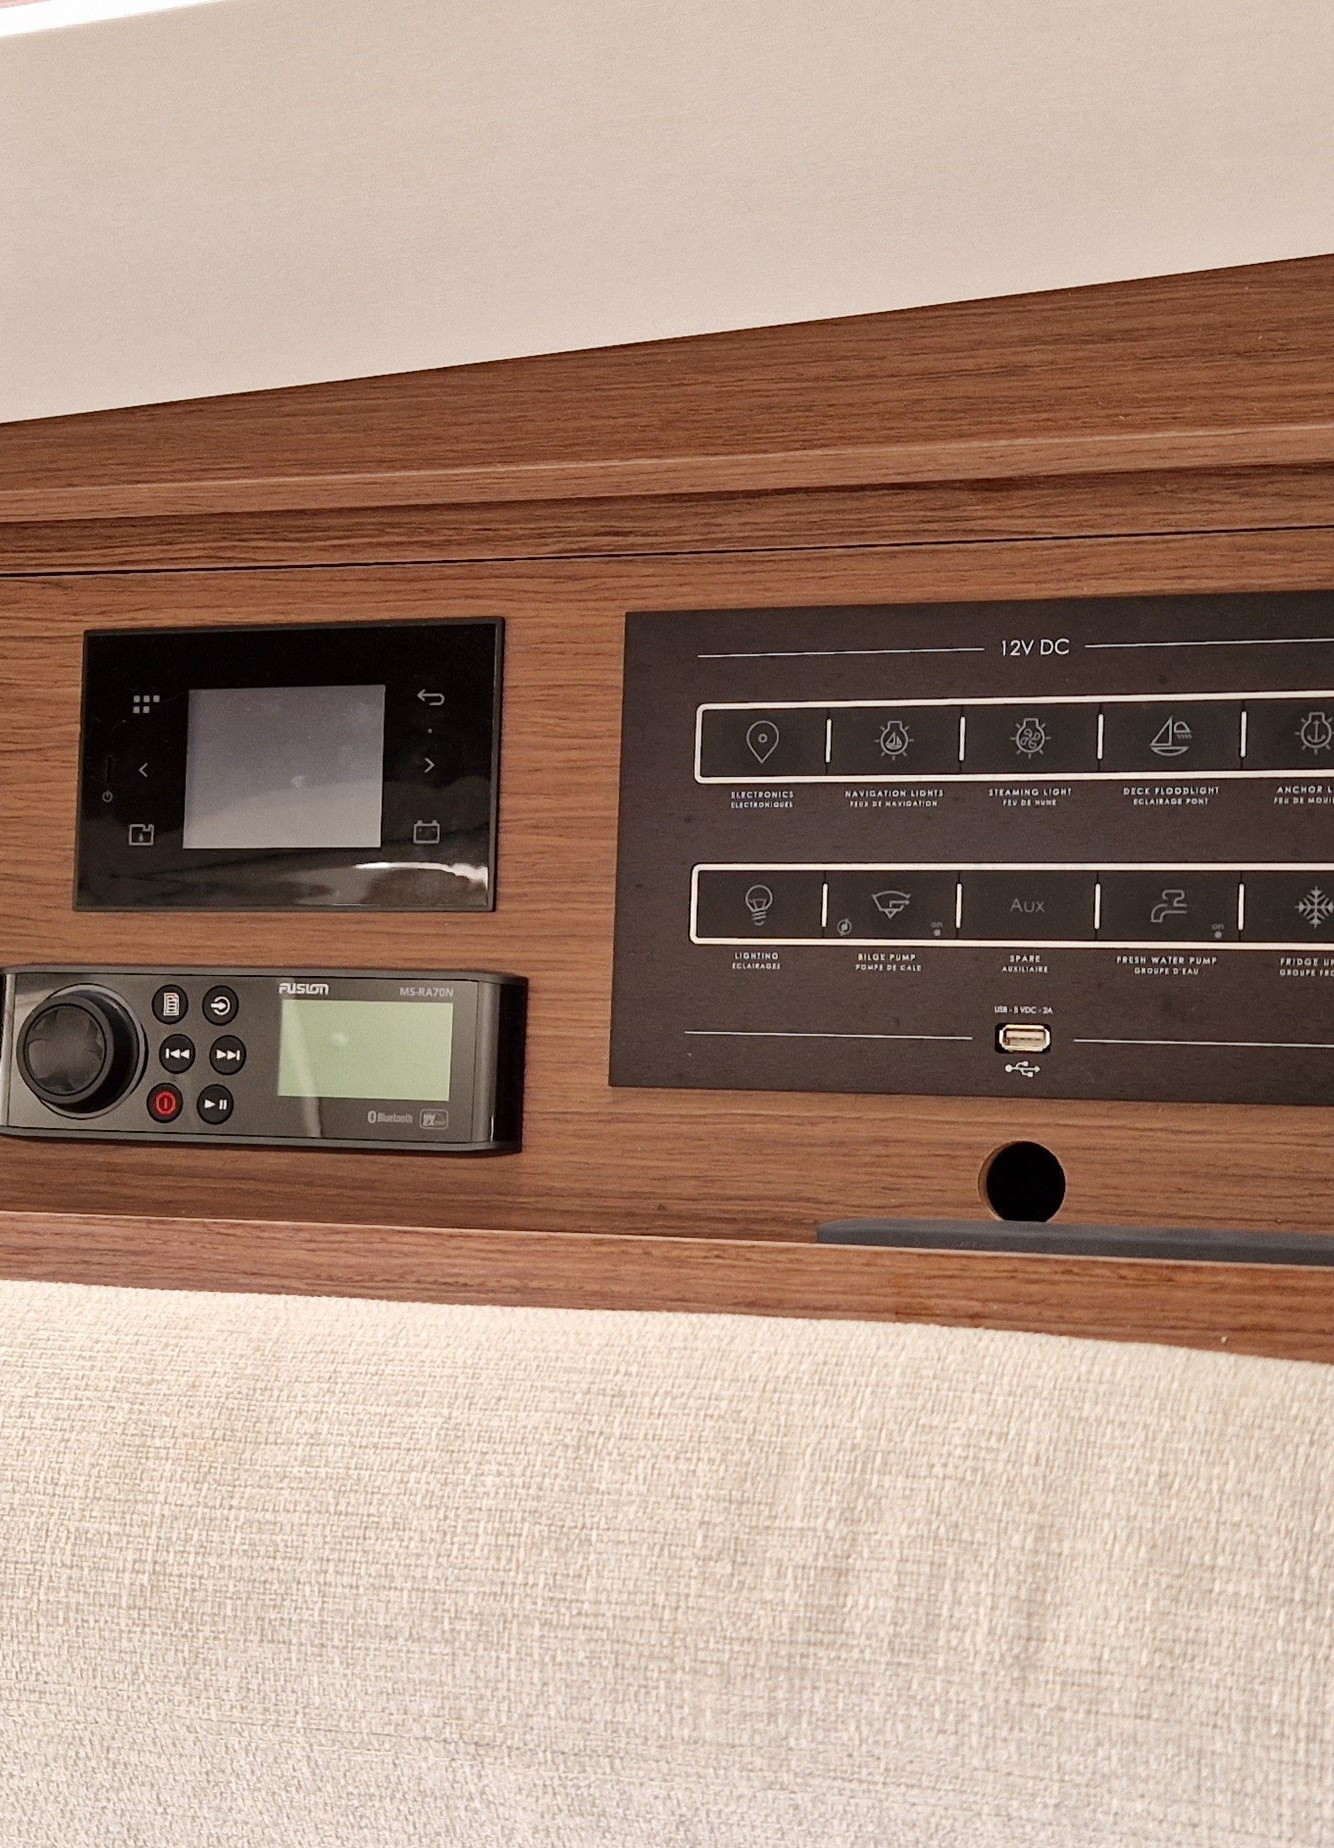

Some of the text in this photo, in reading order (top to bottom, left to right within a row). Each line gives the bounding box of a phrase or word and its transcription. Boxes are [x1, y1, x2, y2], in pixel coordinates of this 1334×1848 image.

[1001, 638, 1070, 656] 12V DC
[844, 789, 944, 798] NAVIGATION LIGHTS
[988, 787, 1072, 797] STEAMING LIGHT
[1123, 786, 1219, 796] DECK FLOODLIGHT
[1276, 785, 1323, 794] ANCHOR
[730, 790, 794, 799] ELECTRONICS
[730, 800, 793, 809] ELECTRONIQUES
[849, 799, 938, 808] FEUX DE NAVIGATION
[1002, 798, 1018, 807] FEU
[1020, 798, 1032, 807] DE
[1133, 797, 1208, 806] ECLAIRAGE PONT
[1273, 796, 1289, 805] FEU
[1292, 796, 1304, 805] DE
[1211, 923, 1225, 931] on
[734, 951, 779, 960] LIGHTING
[857, 952, 916, 962] BILGE PUMP
[1009, 954, 1041, 963] SPARE
[1116, 955, 1217, 965] FRESH WATER PUMP
[731, 962, 781, 970] ECLAIRAGES
[1280, 957, 1319, 967] FRIDGE
[855, 963, 922, 972] POMPE DE CALE
[1001, 965, 1048, 973] AUXILIAIRE
[1134, 967, 1199, 976] GROUPE D'EAU
[1279, 968, 1316, 977] GROUPE
[399, 986, 455, 998] MS-RA70N
[1019, 1005, 1037, 1015] VDC
[1042, 1006, 1053, 1015] 2A
[377, 1112, 413, 1124] Bluetooth
